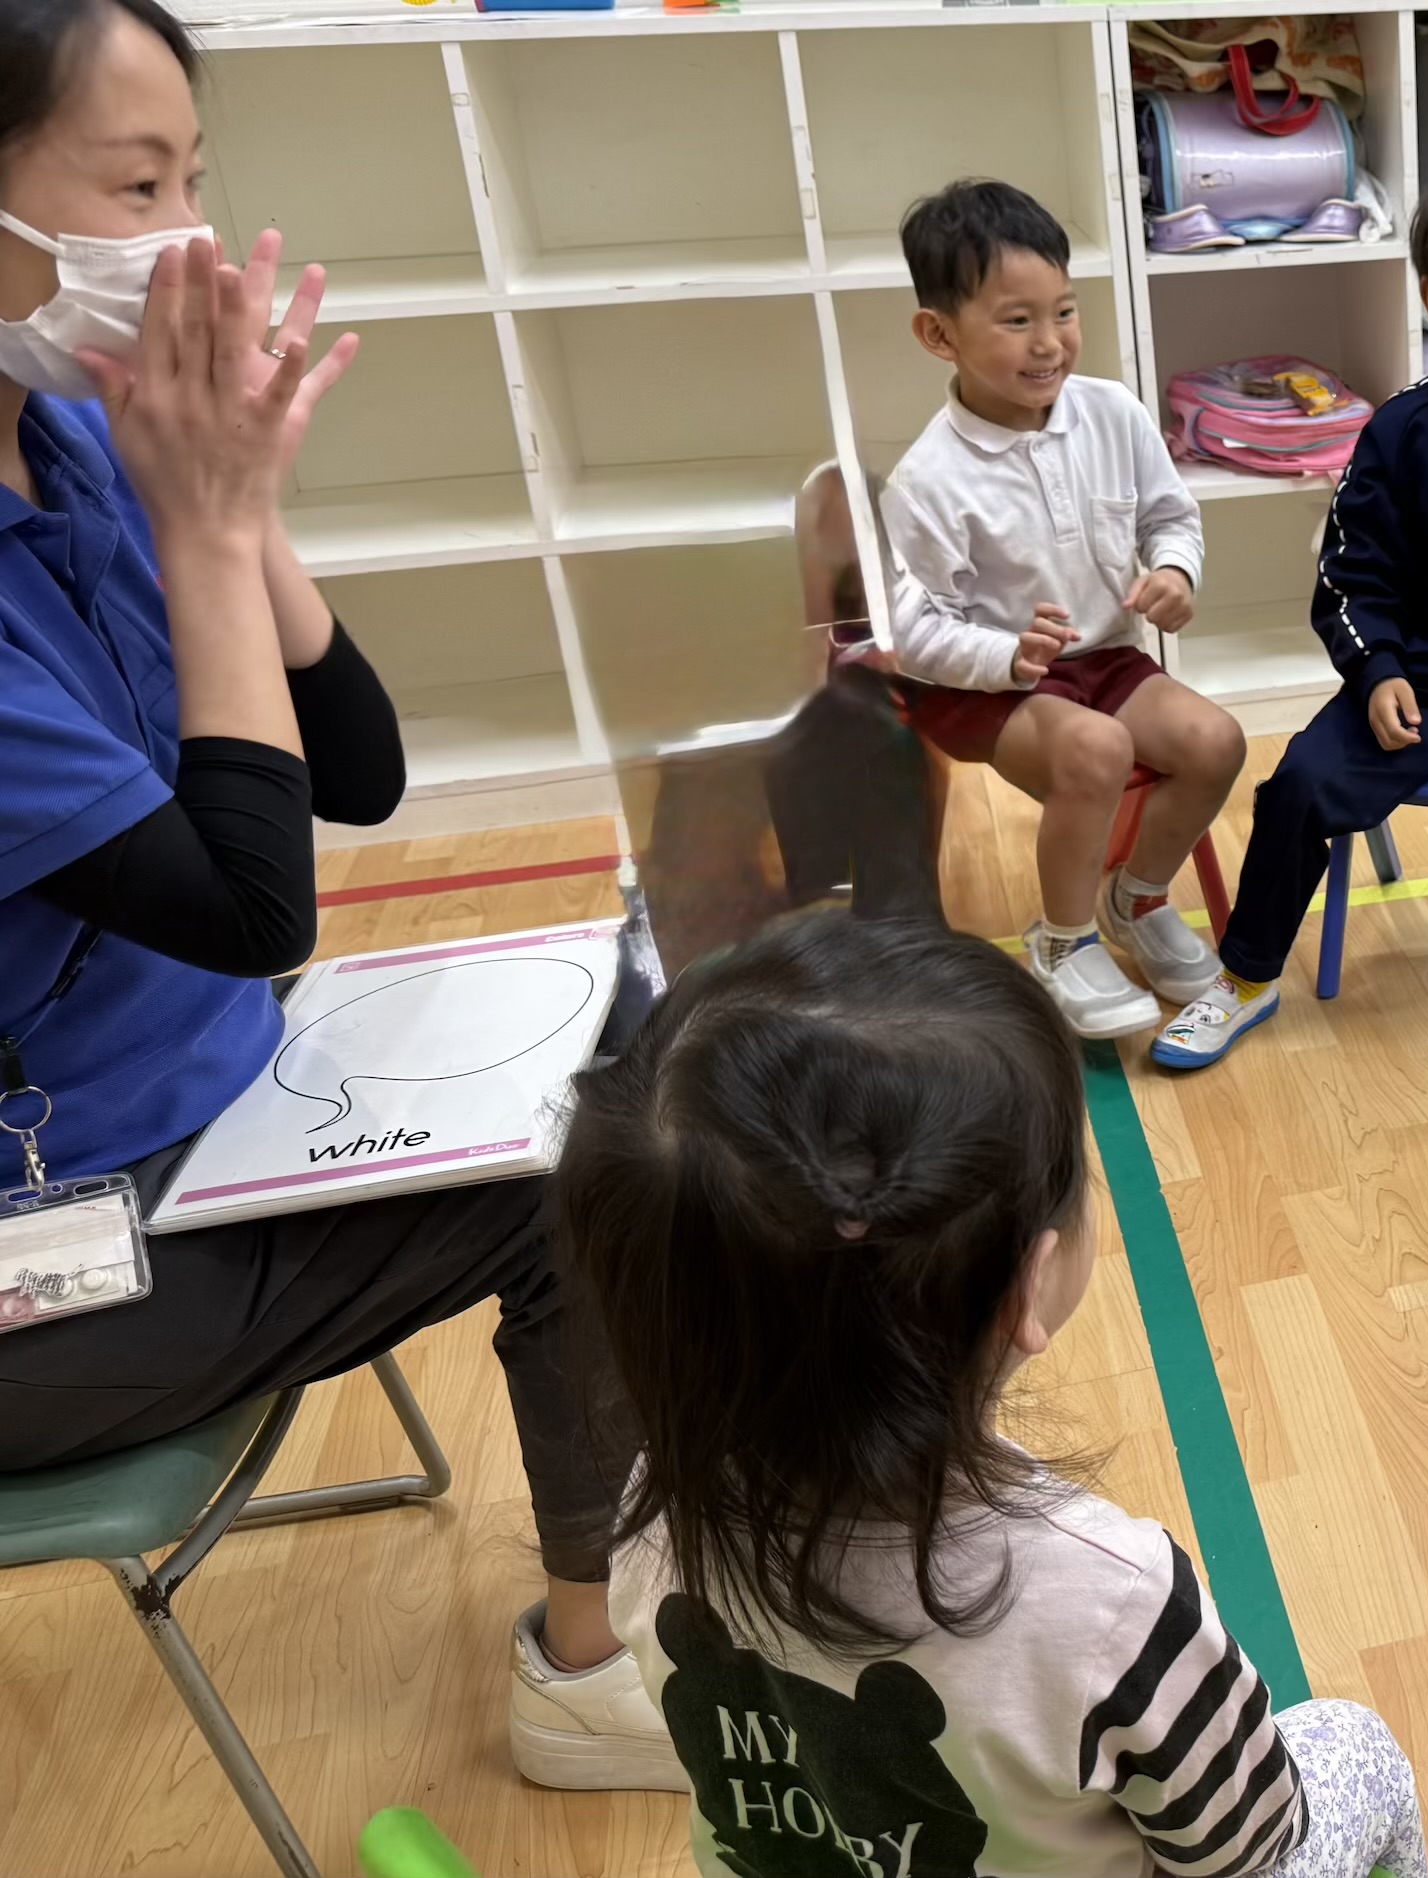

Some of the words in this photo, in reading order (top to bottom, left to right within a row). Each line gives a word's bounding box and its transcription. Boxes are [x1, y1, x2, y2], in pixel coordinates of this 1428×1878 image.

[309, 1127, 431, 1163] white
[716, 1704, 800, 1768] MY
[728, 1777, 923, 1878] HOBY
